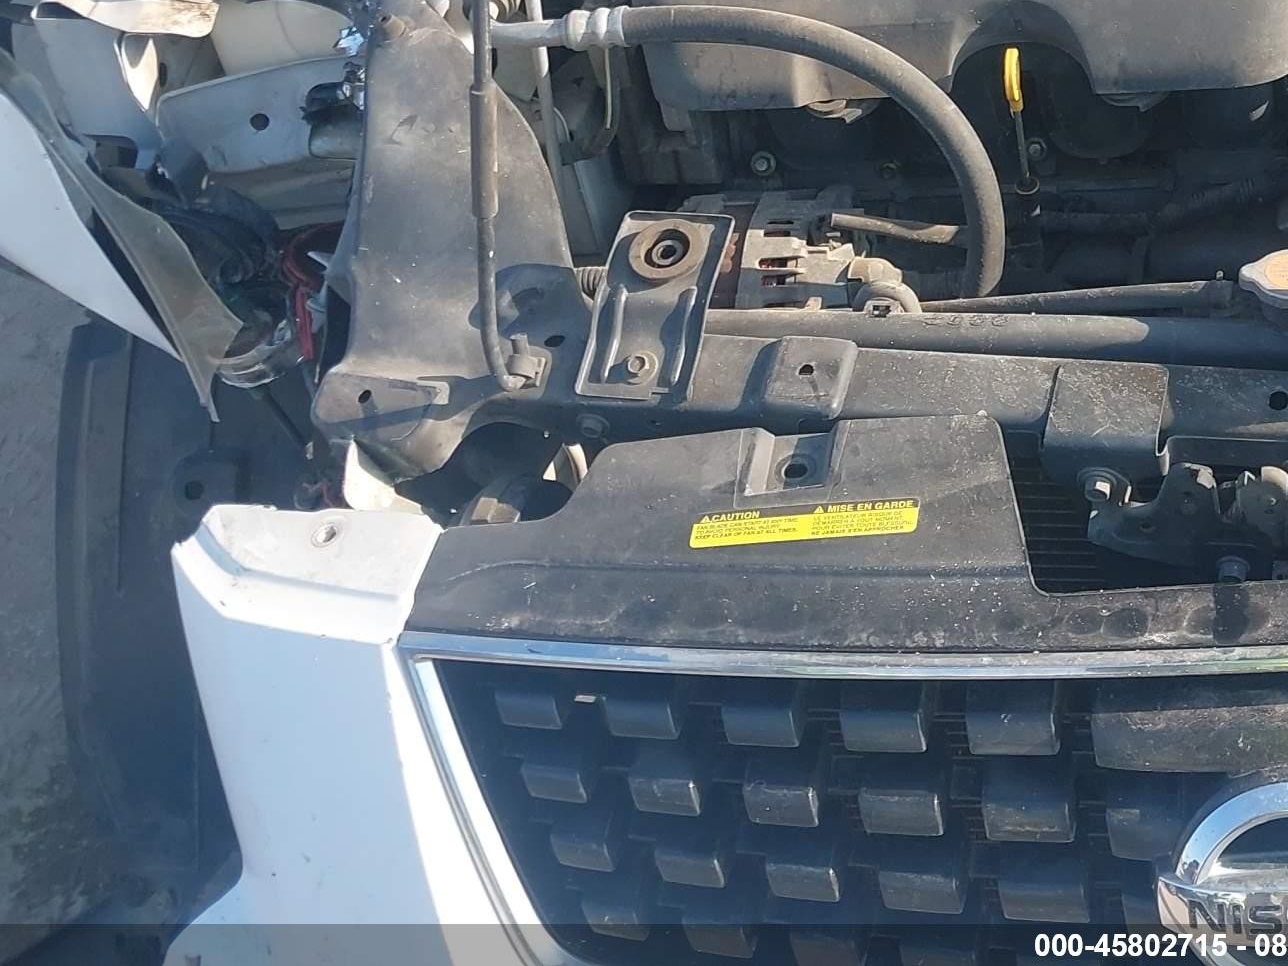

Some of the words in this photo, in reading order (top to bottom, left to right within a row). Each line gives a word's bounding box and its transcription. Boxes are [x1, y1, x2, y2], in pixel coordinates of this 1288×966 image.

[827, 504, 854, 513] MISE
[857, 502, 872, 511] EN
[875, 500, 914, 510] GARDE
[711, 511, 760, 522] CAUTION
